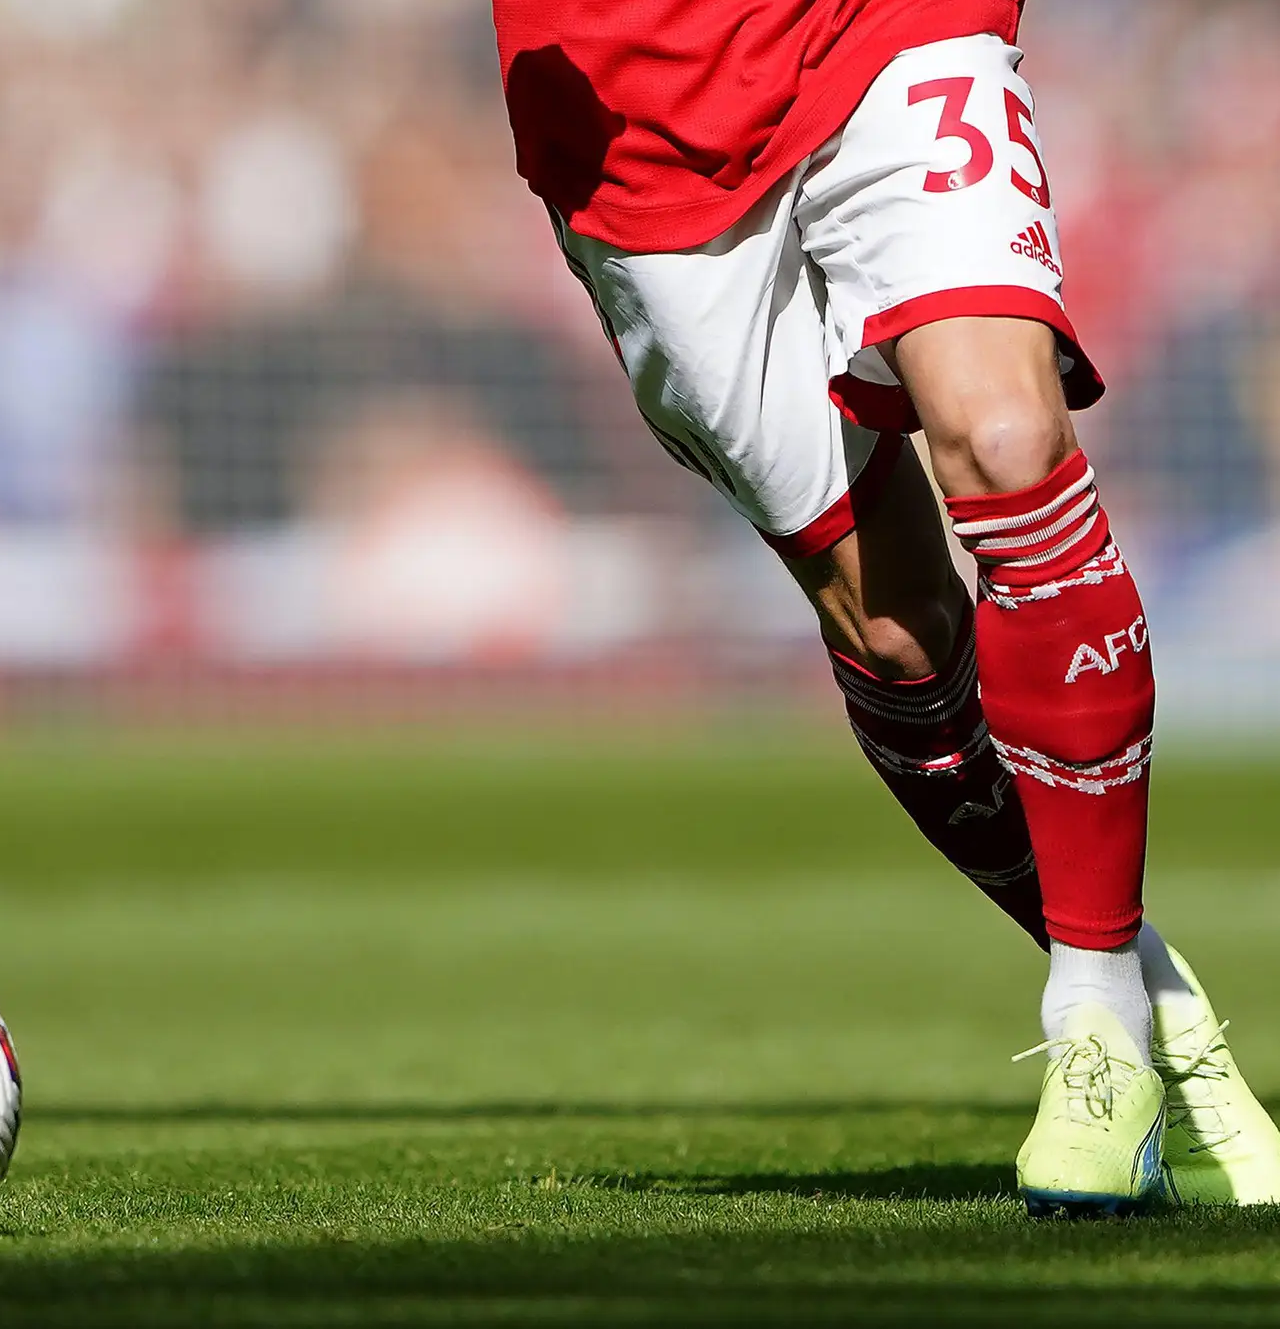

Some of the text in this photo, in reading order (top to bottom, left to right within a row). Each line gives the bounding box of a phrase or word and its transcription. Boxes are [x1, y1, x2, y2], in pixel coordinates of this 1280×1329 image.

[908, 77, 1051, 209] 35
[1010, 241, 1062, 278] adidas
[1064, 615, 1148, 683] AFC
